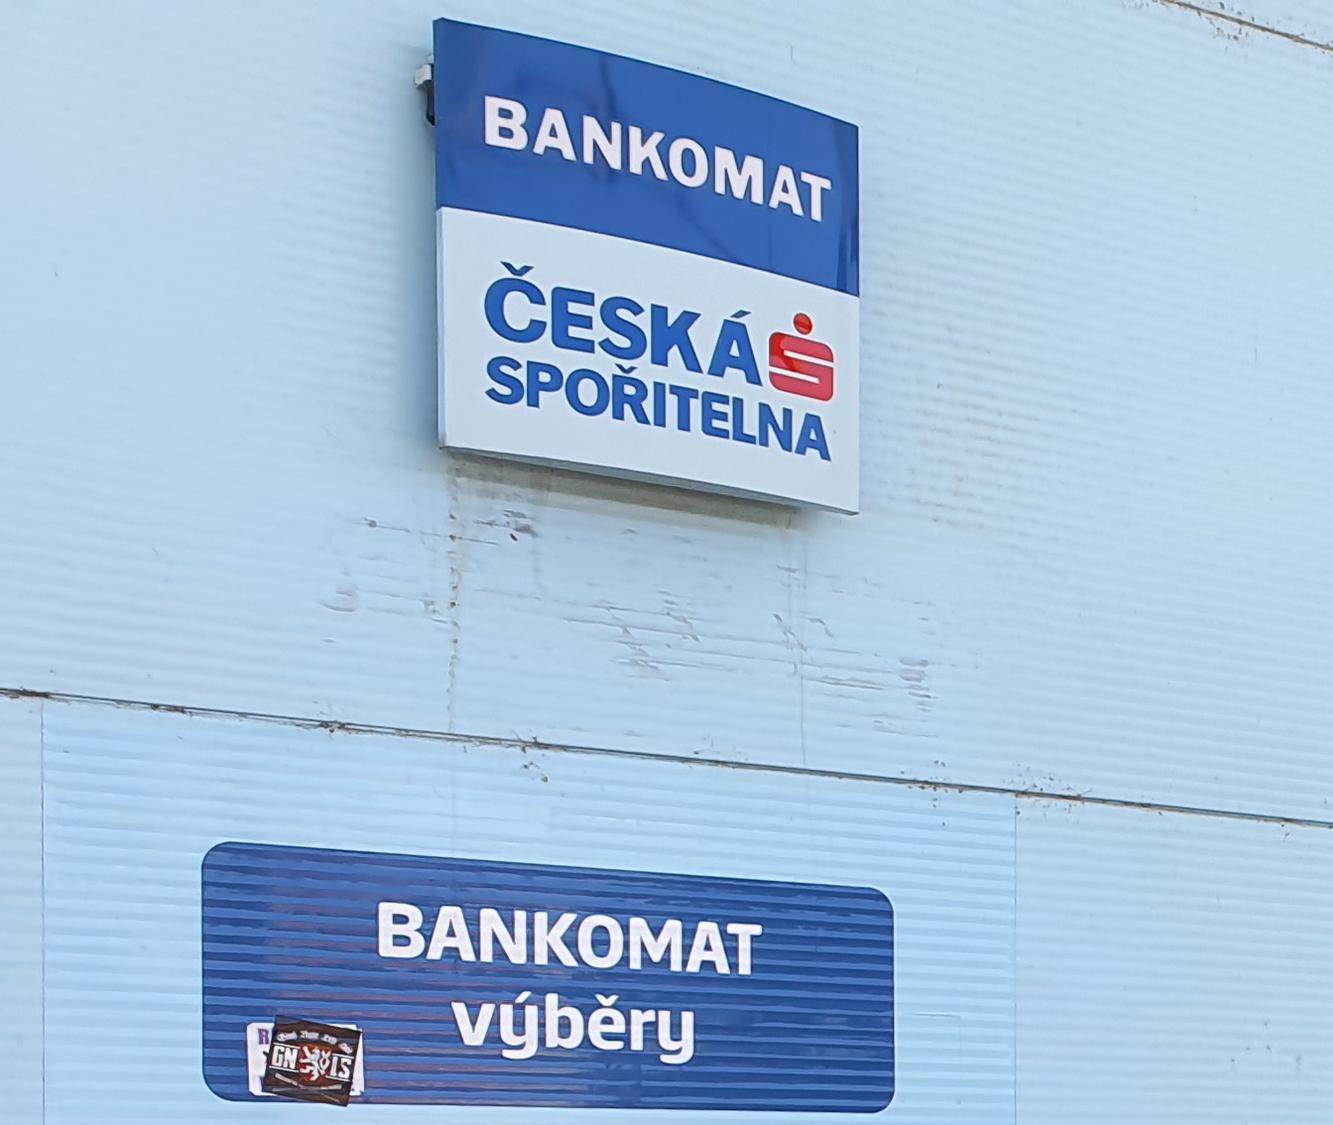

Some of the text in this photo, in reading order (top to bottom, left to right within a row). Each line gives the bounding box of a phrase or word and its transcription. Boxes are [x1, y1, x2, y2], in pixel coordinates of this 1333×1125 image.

[484, 95, 832, 222] BANKOMAT
[484, 261, 763, 387] ČESKÁ
[484, 355, 832, 463] SPOŘITELNA
[376, 901, 763, 976] BANKOMAT
[451, 991, 696, 1064] výběry
